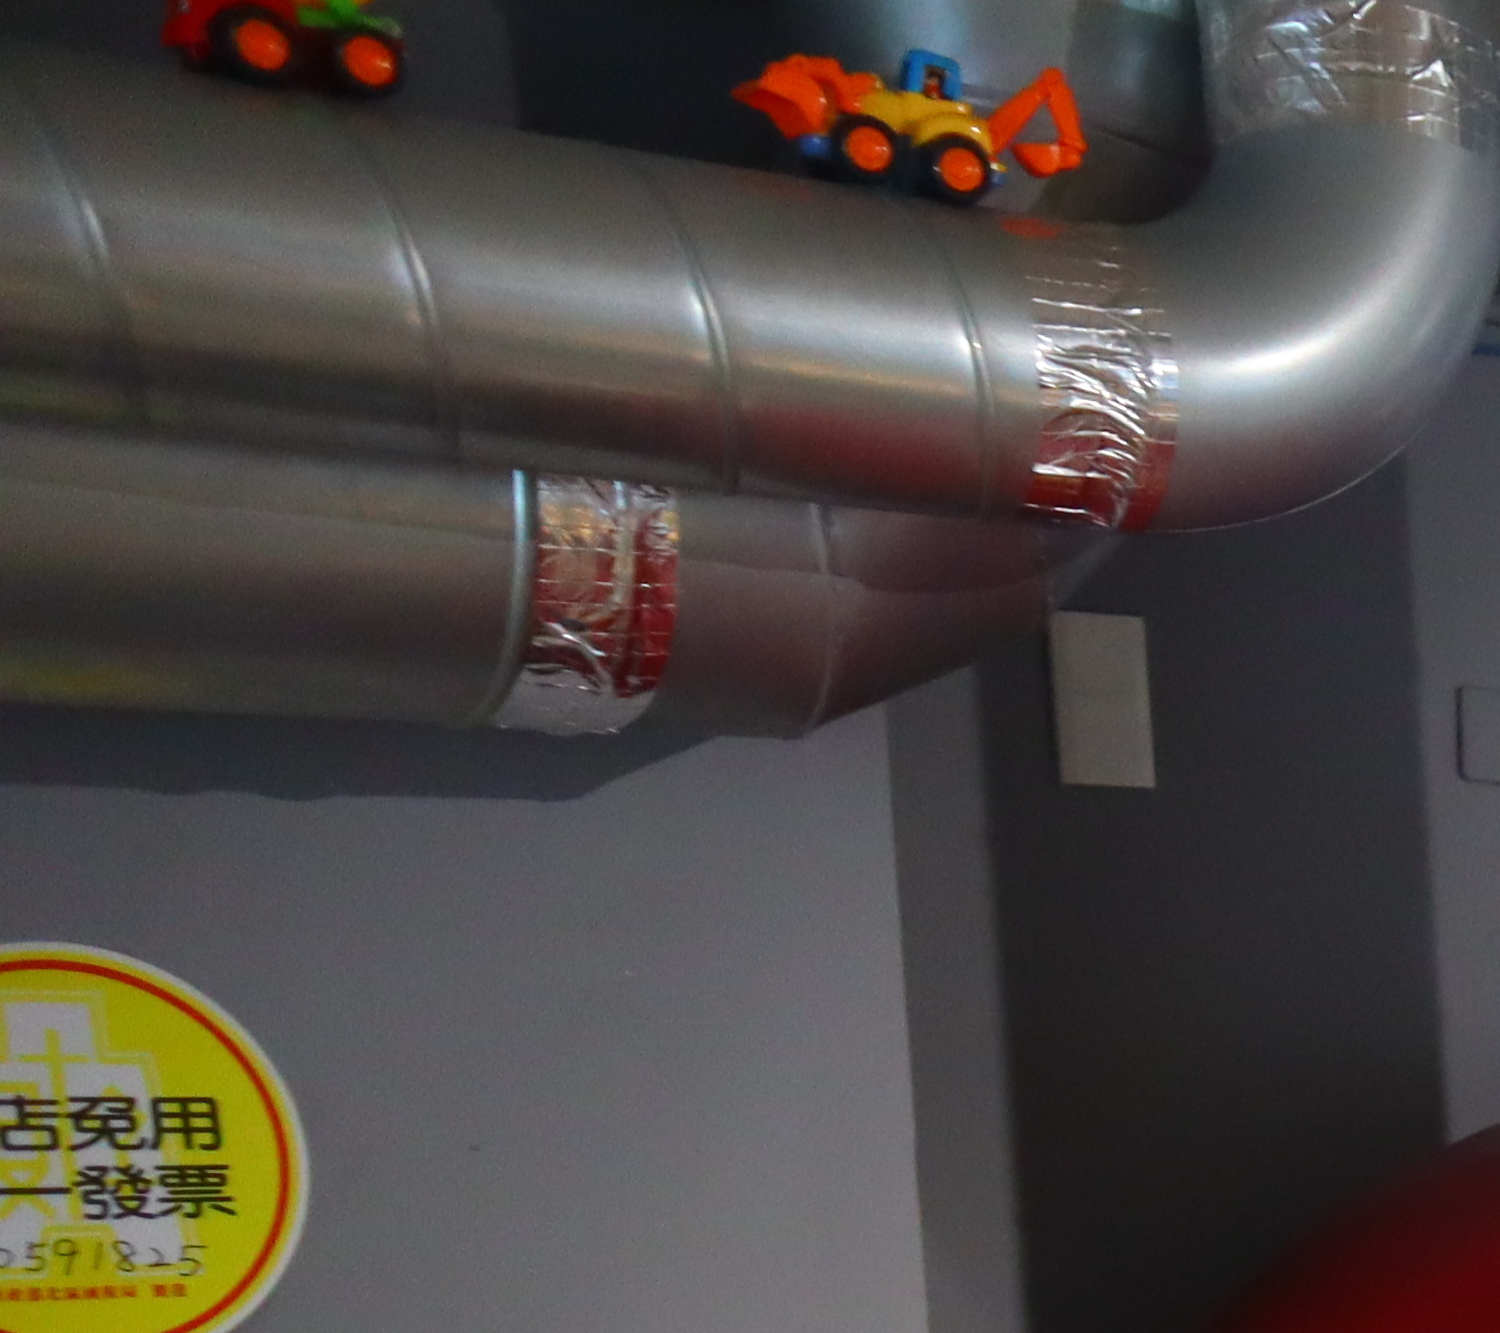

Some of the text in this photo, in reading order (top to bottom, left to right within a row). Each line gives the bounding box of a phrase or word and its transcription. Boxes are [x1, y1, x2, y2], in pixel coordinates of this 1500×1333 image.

[0, 1094, 222, 1151] 店免用
[0, 1165, 238, 1220] 一發票
